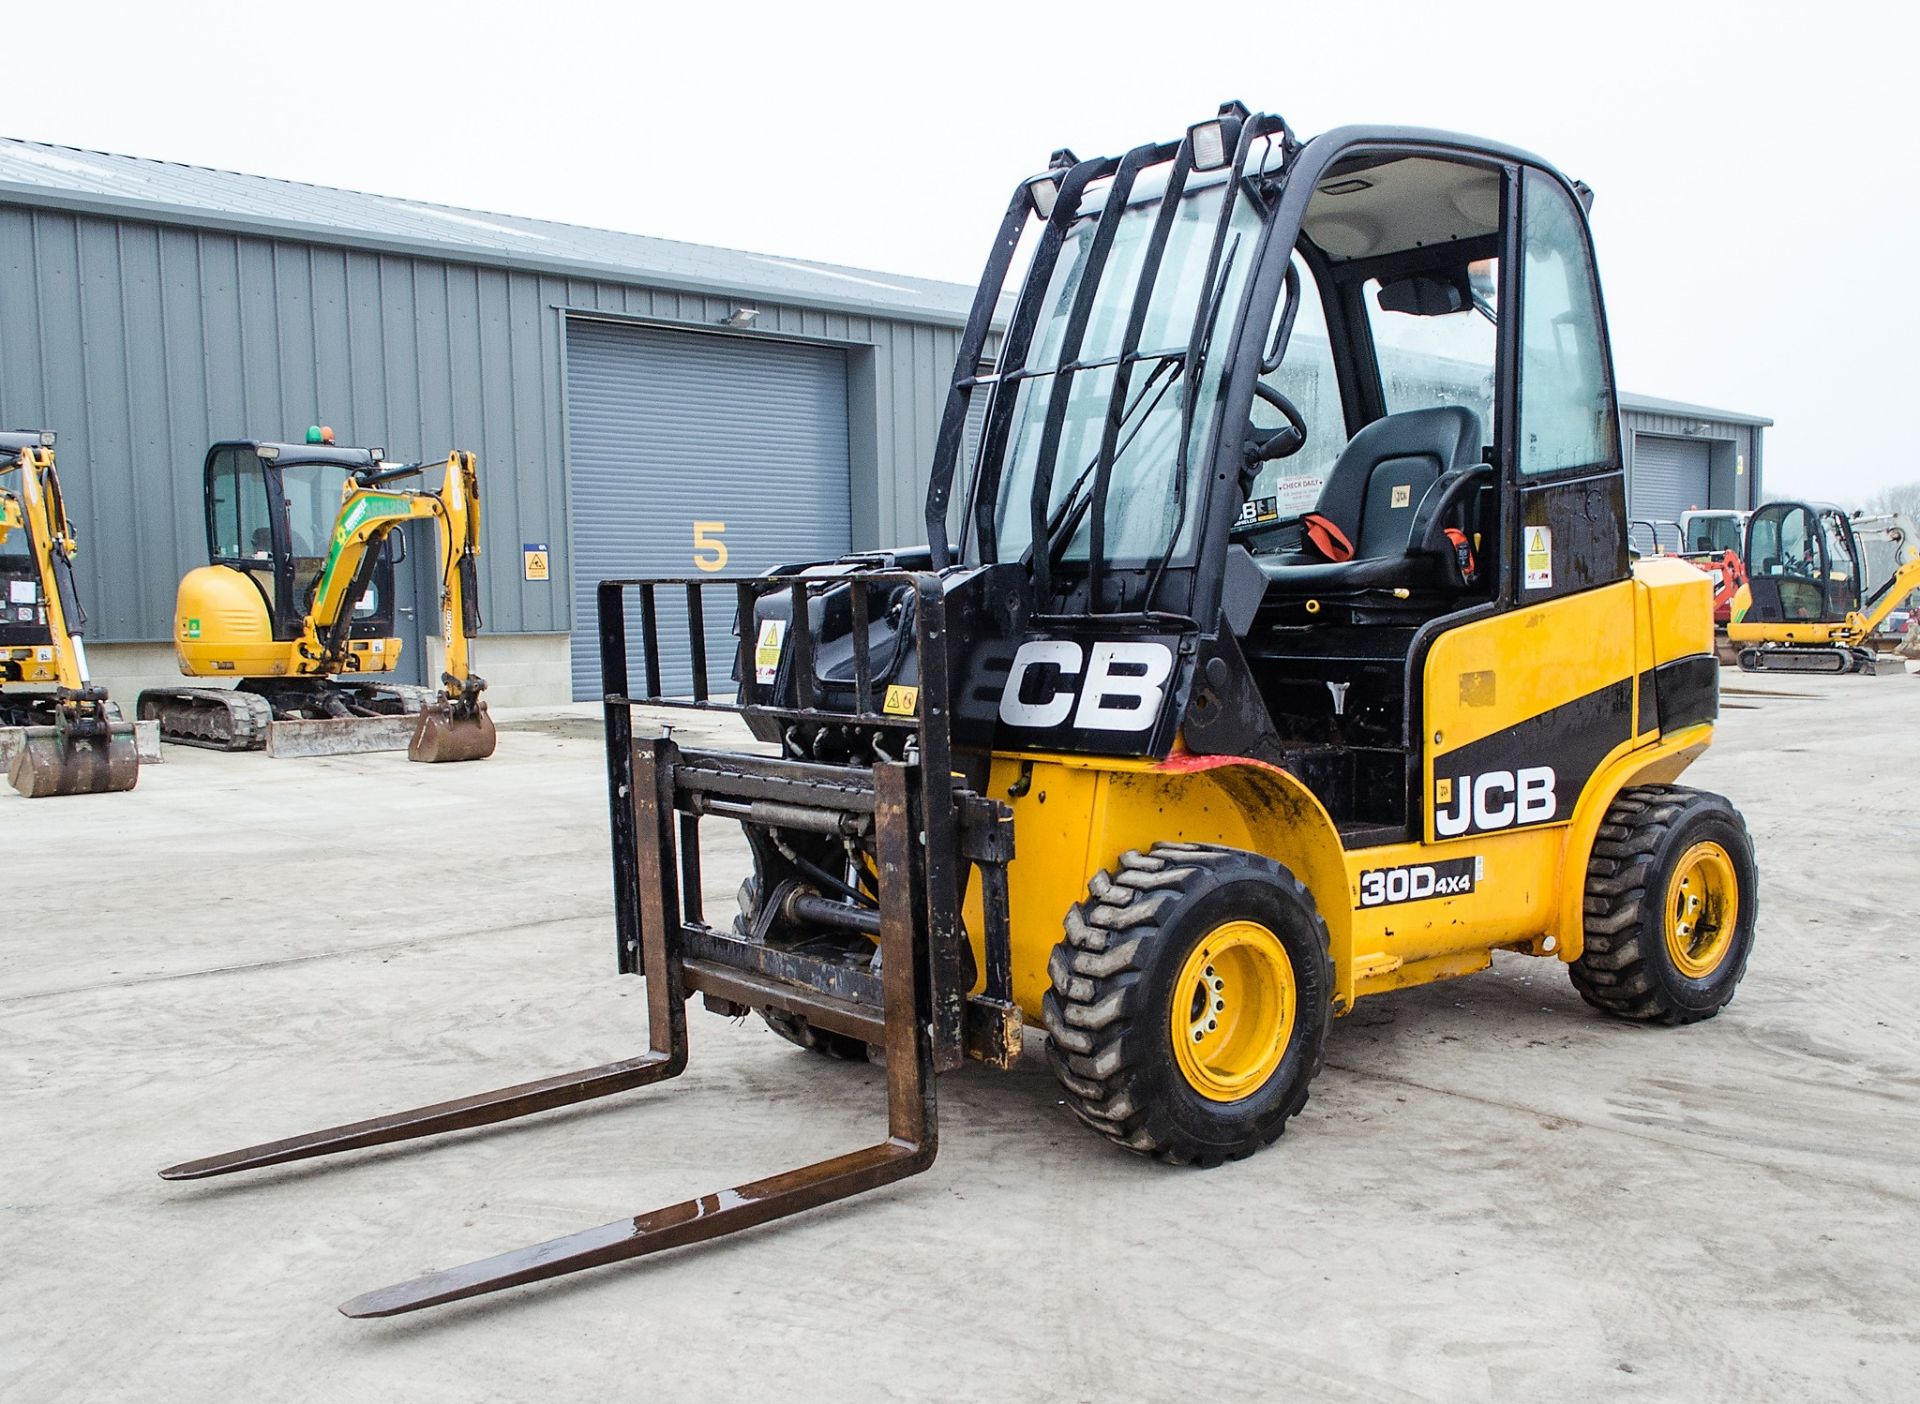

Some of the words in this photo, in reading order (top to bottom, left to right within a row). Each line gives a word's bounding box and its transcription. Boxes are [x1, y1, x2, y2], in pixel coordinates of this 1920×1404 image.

[1282, 482, 1302, 490] CHECK
[1302, 480, 1319, 488] DAILY
[693, 521, 728, 572] 5
[999, 640, 1173, 732] CB
[1436, 766, 1557, 836] JCB
[1361, 866, 1436, 906] 30D
